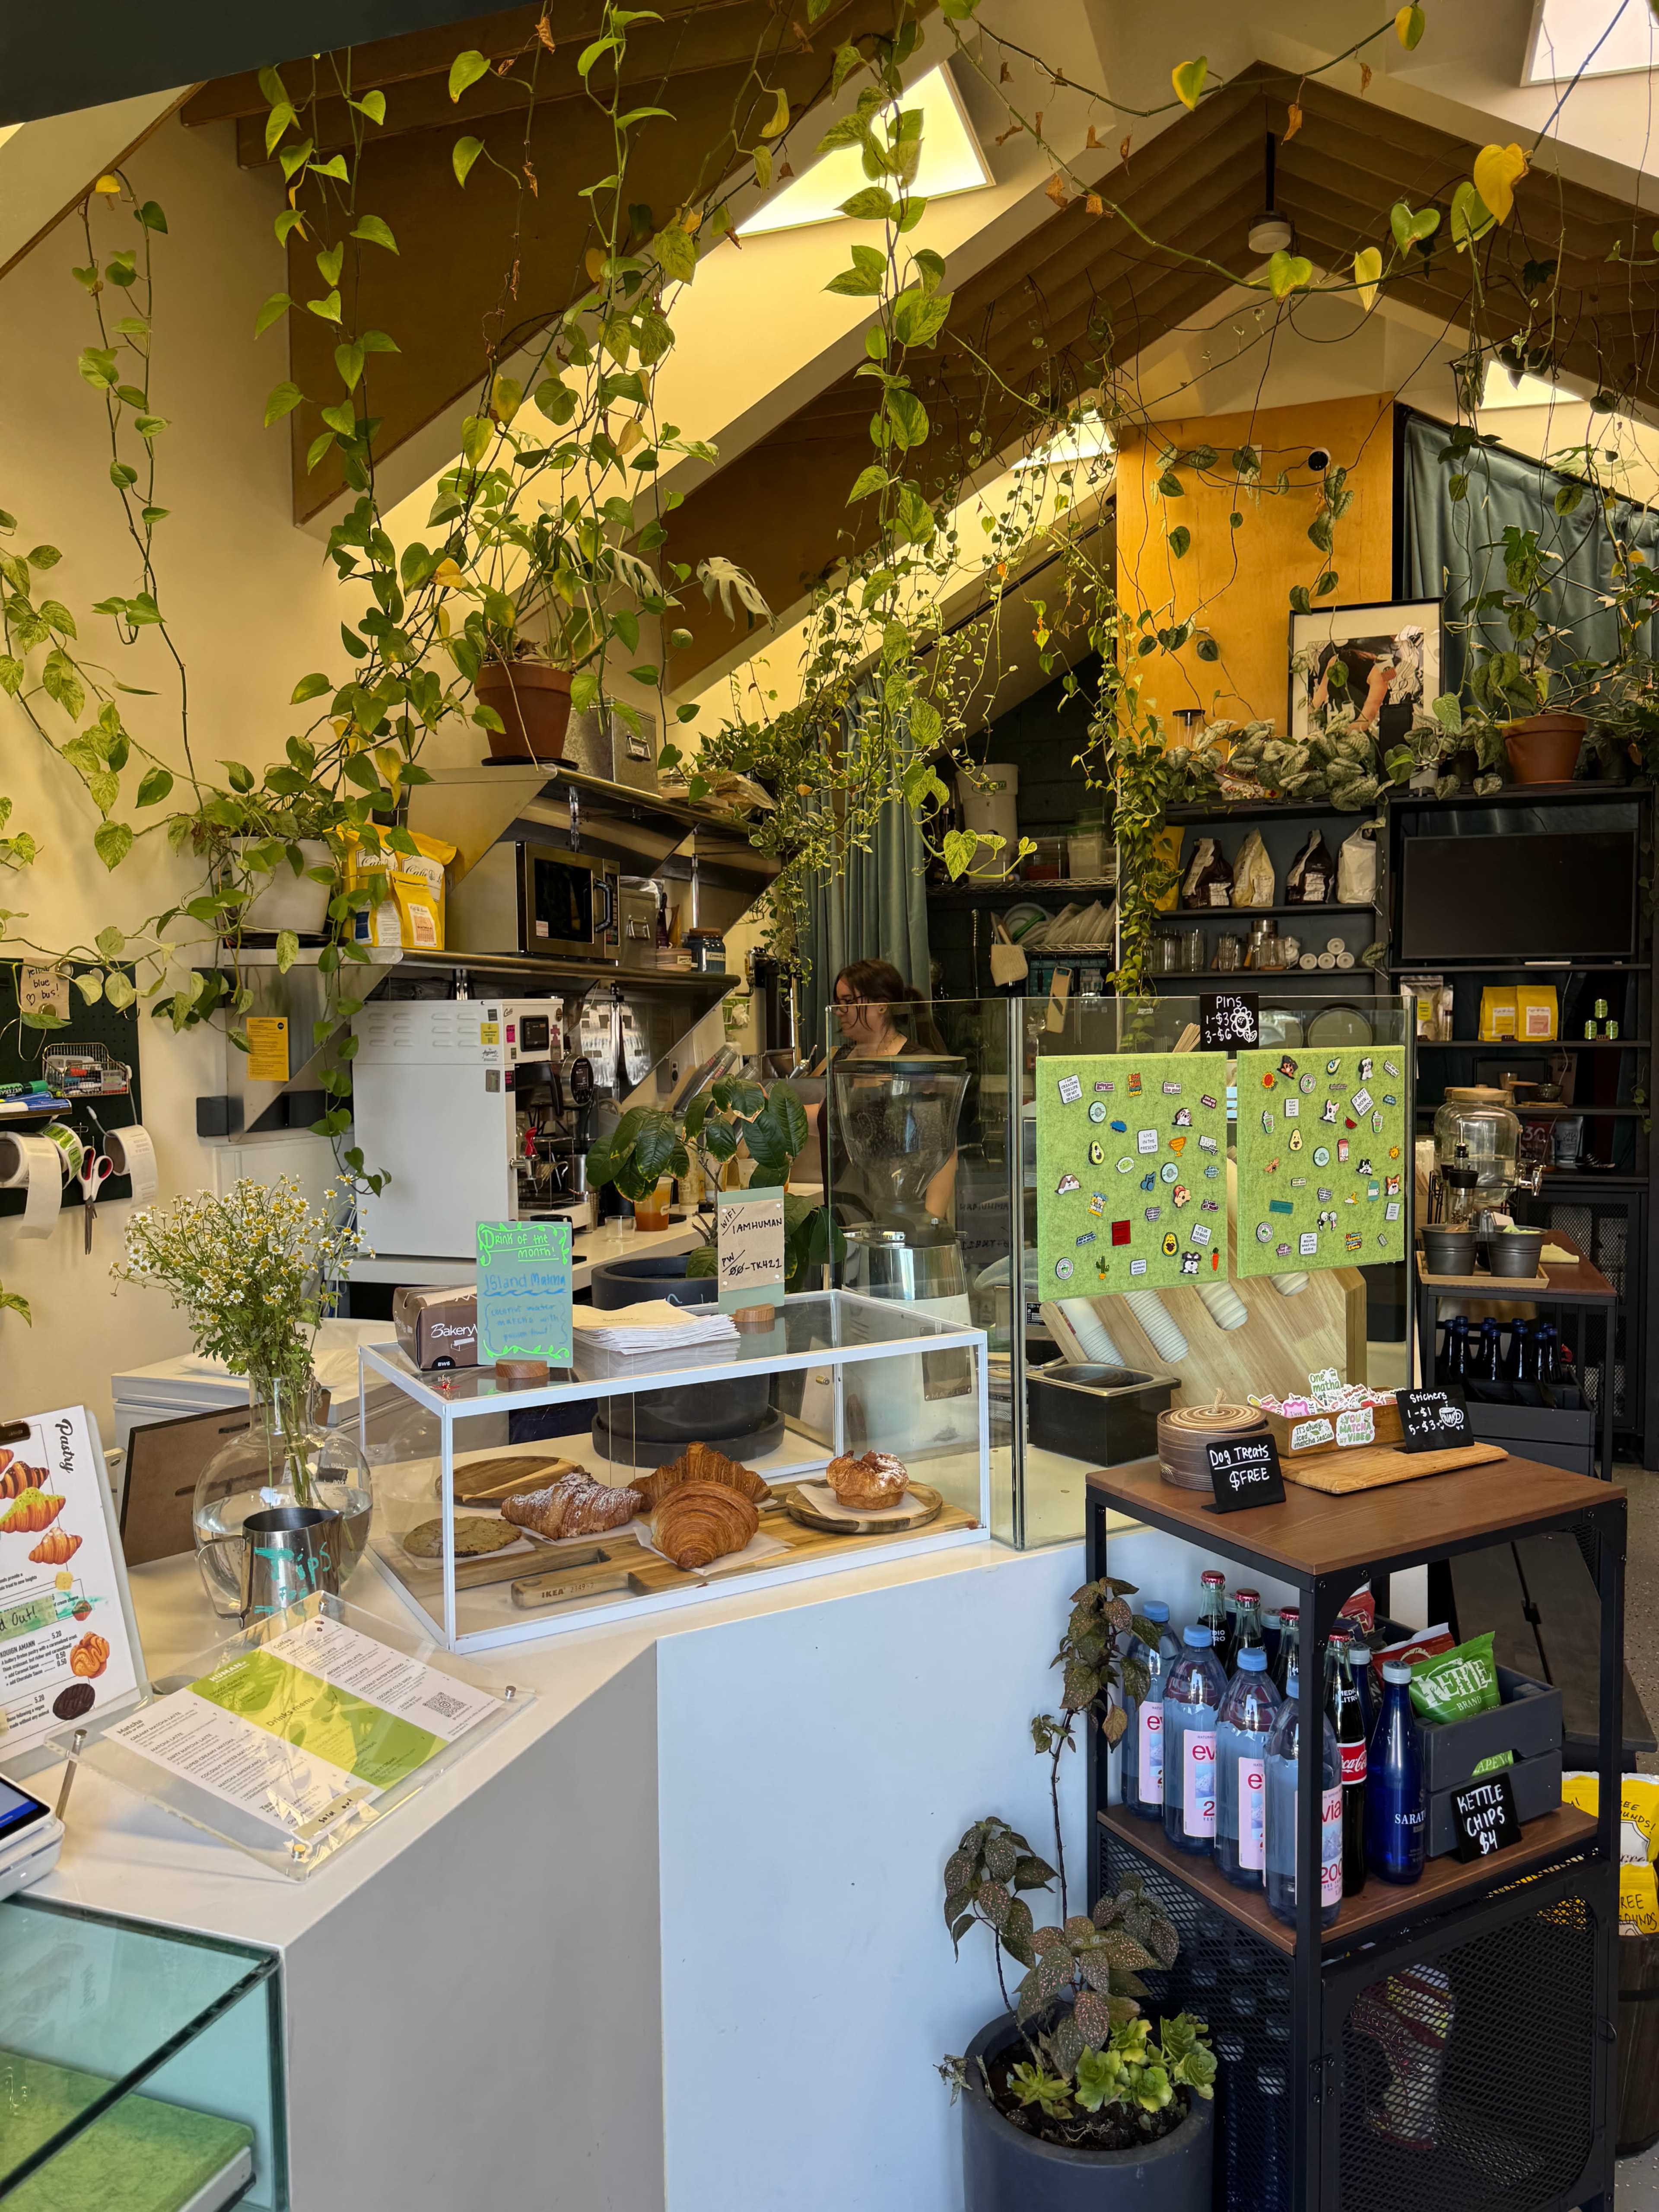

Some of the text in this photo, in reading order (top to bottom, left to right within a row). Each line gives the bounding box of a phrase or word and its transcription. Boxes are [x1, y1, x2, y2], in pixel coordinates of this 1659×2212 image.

[33, 979, 50, 988] blue
[41, 983, 59, 999] bus!
[1357, 1090, 1366, 1099] NOT
[518, 1234, 528, 1244] of
[533, 1234, 548, 1244] the
[1193, 1236, 1208, 1244] MISTAKES
[1310, 1374, 1325, 1383] One
[1344, 1413, 1360, 1423] YOU
[1306, 1421, 1323, 1432] always
[1339, 1422, 1371, 1434] MATCHA
[55, 1419, 75, 1474] Pastry
[1294, 1433, 1334, 1448] matcha season
[1209, 1450, 1231, 1466] Dog
[1230, 1467, 1270, 1491] $FREE
[254, 1542, 331, 1584] Tips
[541, 1588, 564, 1598] IKEA
[12, 1606, 37, 1626] Out!
[19, 1640, 35, 1651] AMANN
[52, 1630, 62, 1639] 5.20
[273, 1638, 292, 1649] Coffee
[56, 1651, 66, 1660] 0.50
[57, 1658, 67, 1667] 0.50
[359, 1678, 376, 1692] COCONUT
[386, 1662, 404, 1674] ESPRESSO
[1411, 1659, 1492, 1709] KETTLE
[35, 1694, 44, 1703] 5.20
[377, 1687, 394, 1700] COCONUT
[266, 1696, 315, 1727] Drinks menu
[1457, 1696, 1481, 1711] BRAND
[19, 1716, 32, 1725] without
[116, 1719, 143, 1735] Matcha
[130, 1712, 181, 1741] CREAMY MATCHA LATTE
[150, 1732, 184, 1752] MATCHA LATTE
[167, 1733, 212, 1761] DIRTY MATCHA LATTE
[184, 1738, 235, 1770] SUPER CREAMY MATCHA
[200, 1744, 256, 1779] COCONUT WATER MATCHA
[218, 1759, 262, 1788] MATCHA AMERICANO
[1457, 1784, 1503, 1814] KETTLE
[1467, 1806, 1505, 1837] CHIPS
[1479, 1829, 1497, 1854] $4
